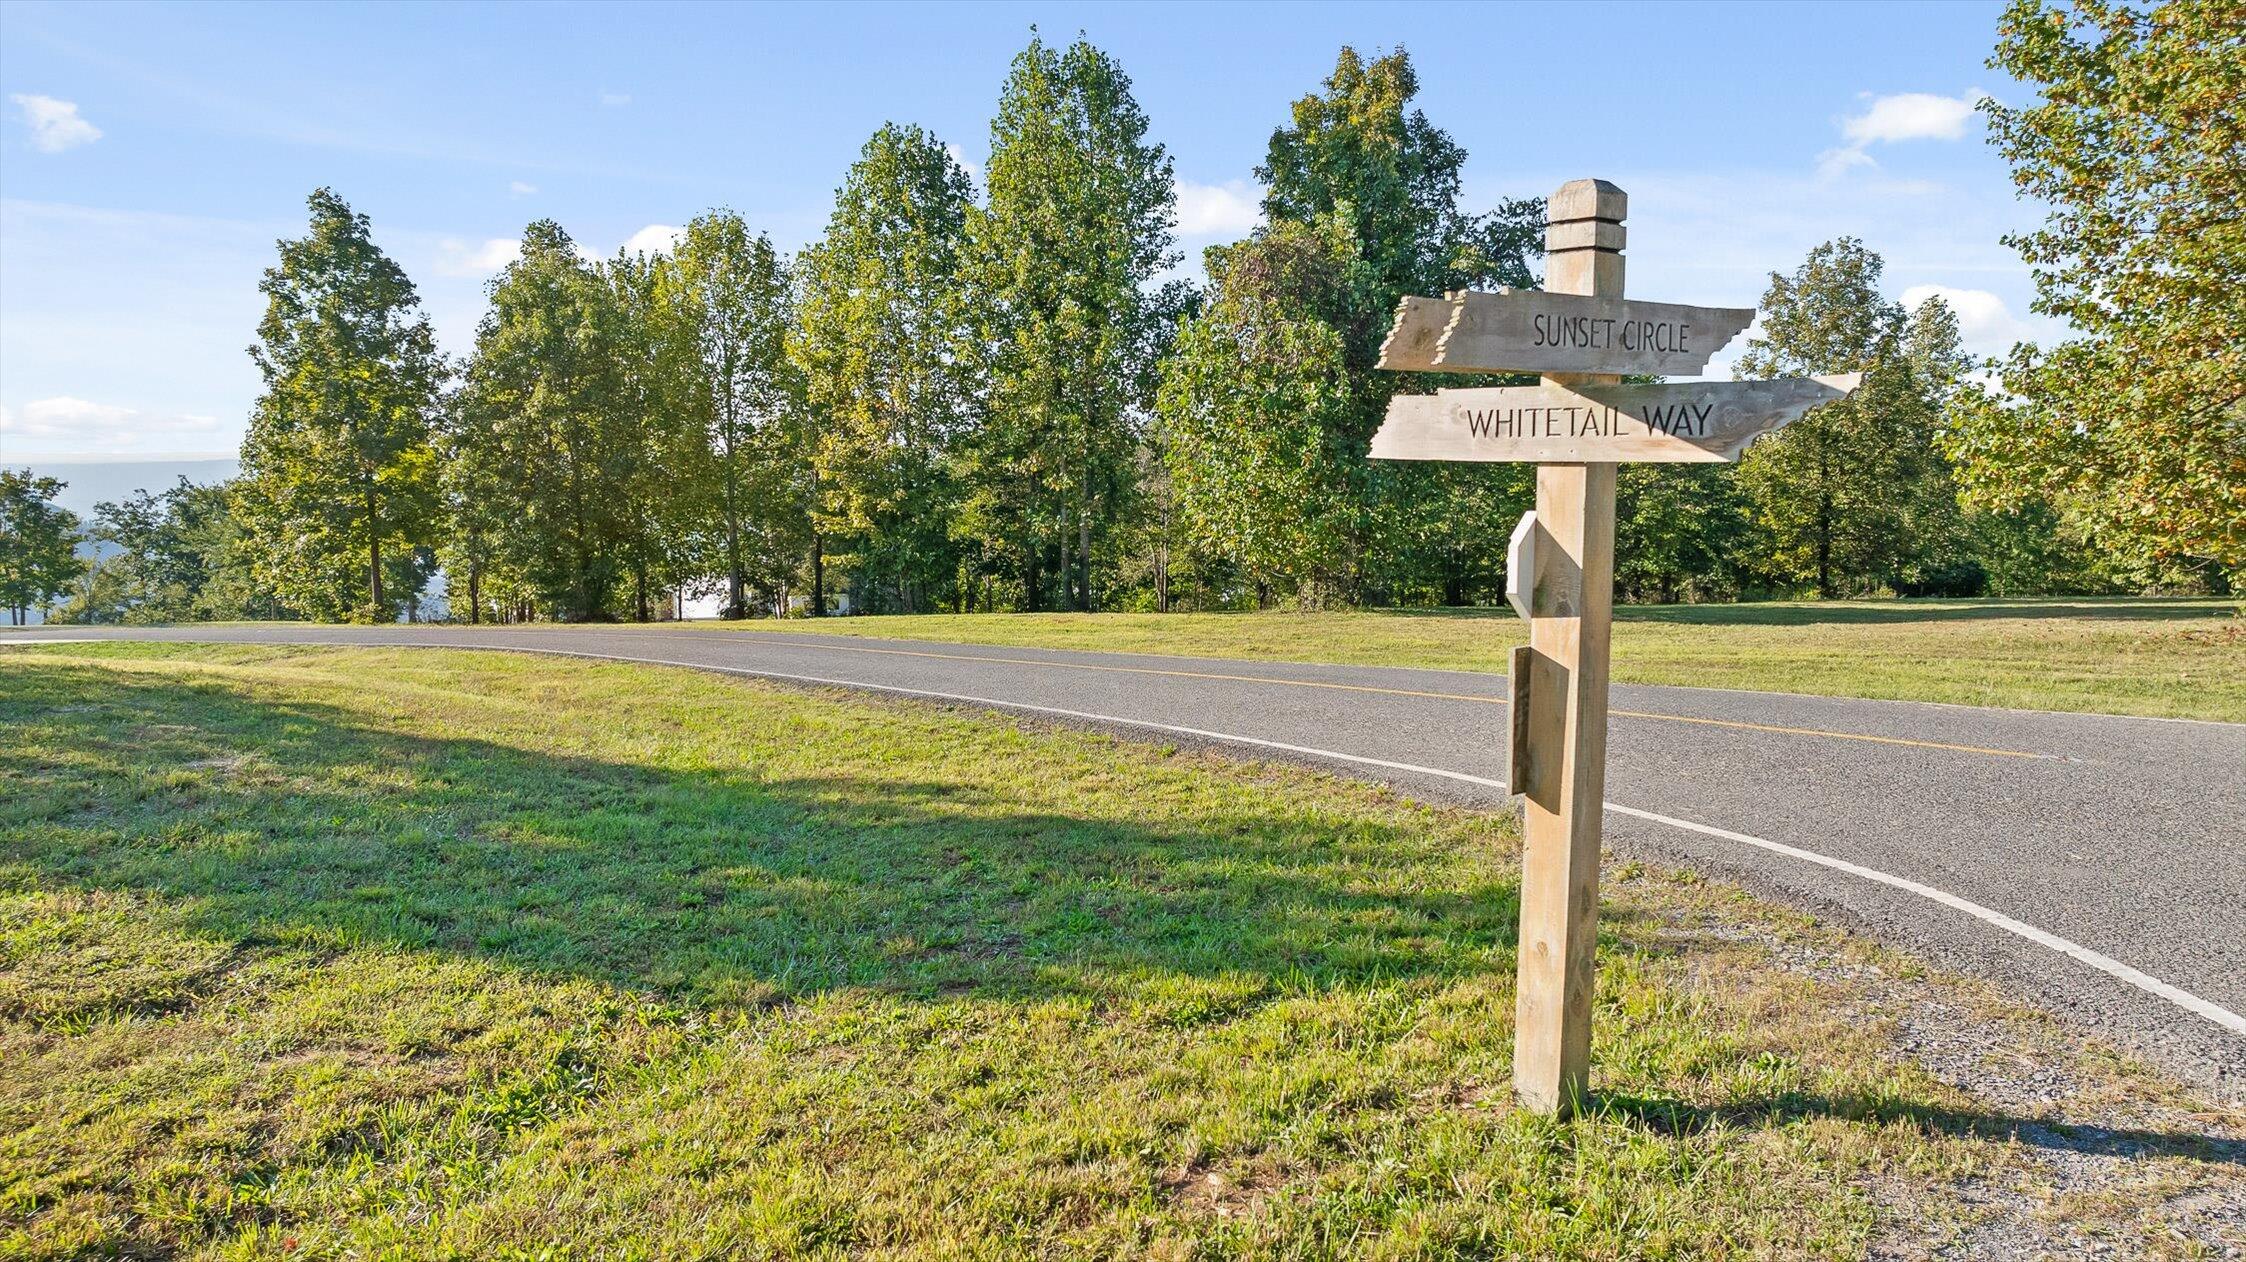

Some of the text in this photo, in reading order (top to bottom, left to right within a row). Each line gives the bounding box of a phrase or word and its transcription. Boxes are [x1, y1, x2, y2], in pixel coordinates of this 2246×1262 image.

[1534, 313, 1690, 353] SUNSET CIRCLE
[1467, 403, 1715, 439] WHITETAIL WAY
